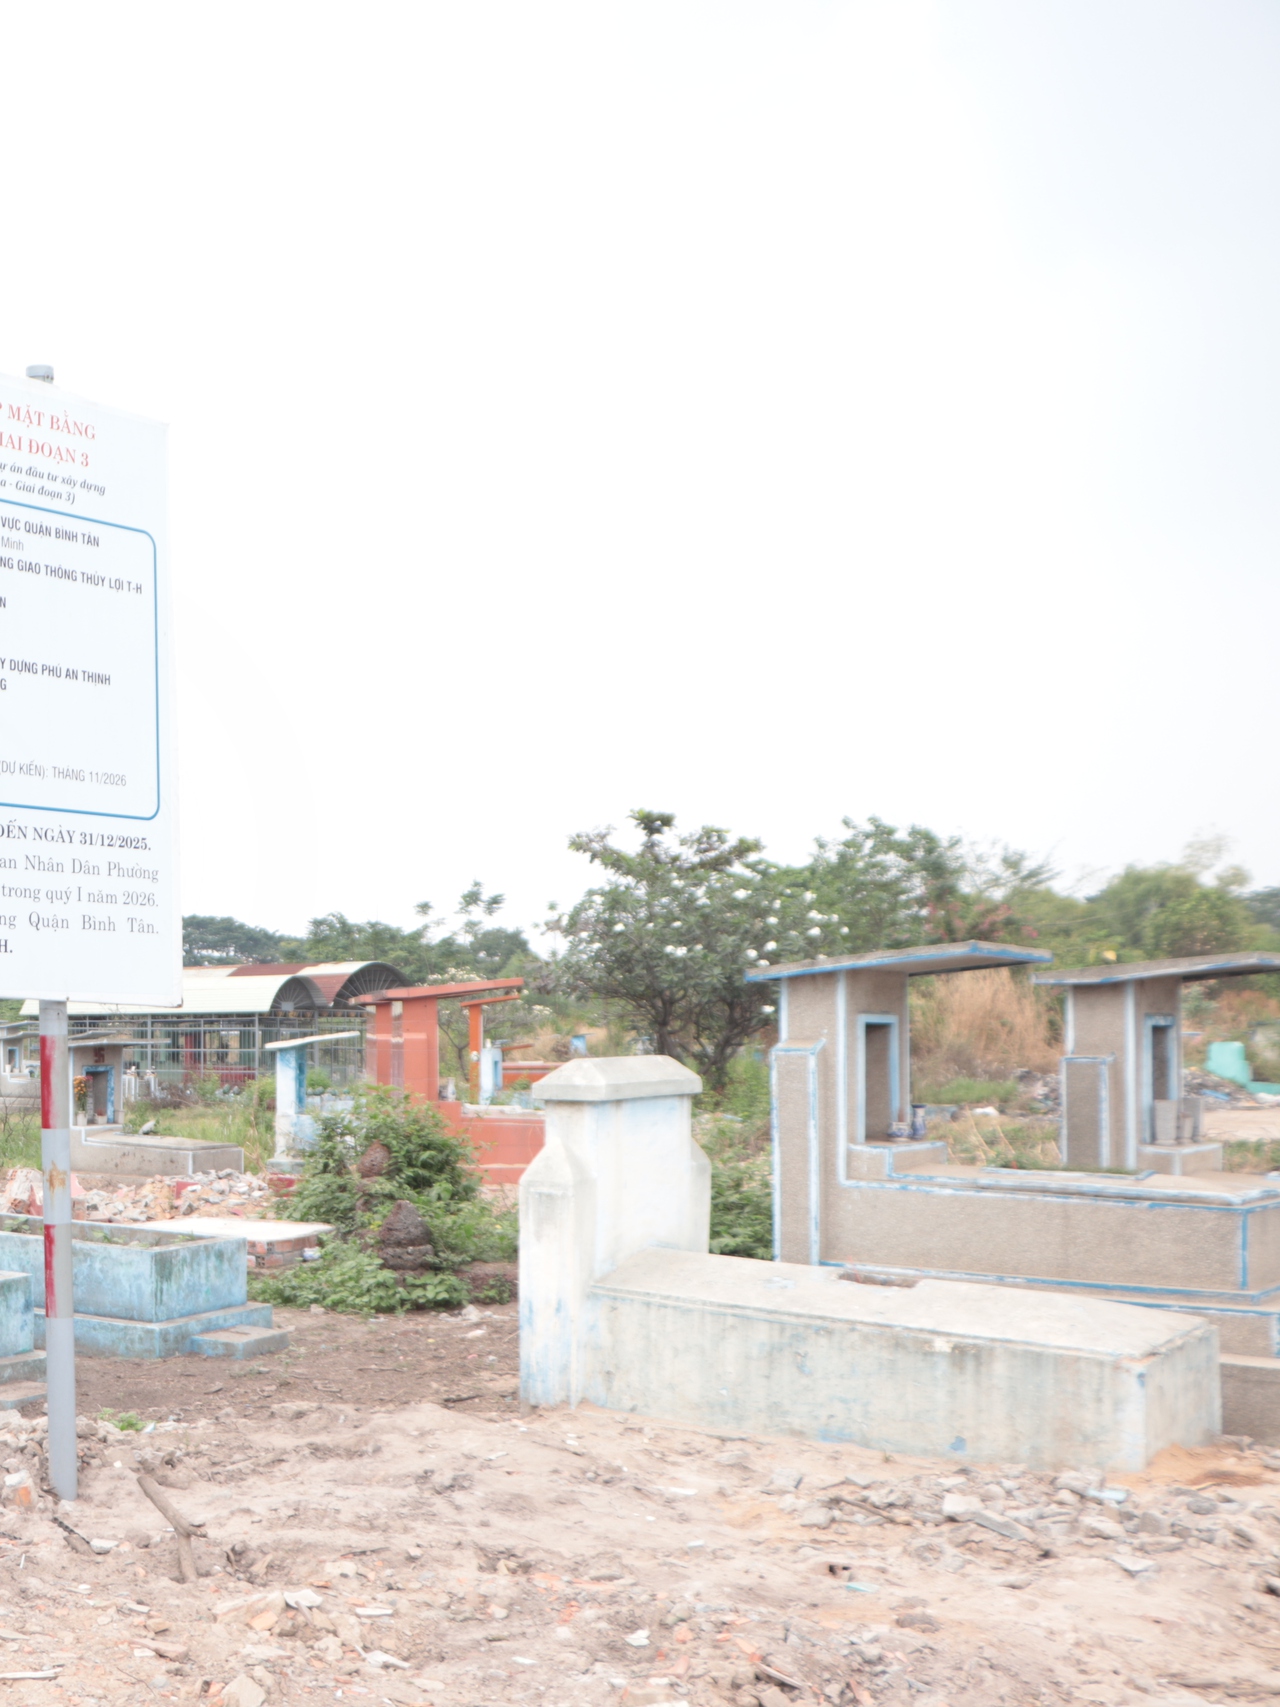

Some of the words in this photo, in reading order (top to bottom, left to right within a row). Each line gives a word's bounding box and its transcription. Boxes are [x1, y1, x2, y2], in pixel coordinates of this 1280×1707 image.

[7, 403, 46, 429] MẶT
[49, 409, 96, 441] BẰNG
[27, 437, 77, 466] ĐOẠN
[80, 451, 90, 468] 3
[8, 461, 24, 476] án
[24, 464, 46, 481] đầu
[46, 470, 60, 484] tư
[59, 474, 79, 491] xây
[78, 478, 107, 498] dựng
[0, 514, 22, 533] VỰC
[23, 519, 53, 539] QUẬN
[79, 530, 101, 549] TÂN
[31, 823, 77, 845] NGÀY
[78, 830, 152, 852] 31/12/2025.
